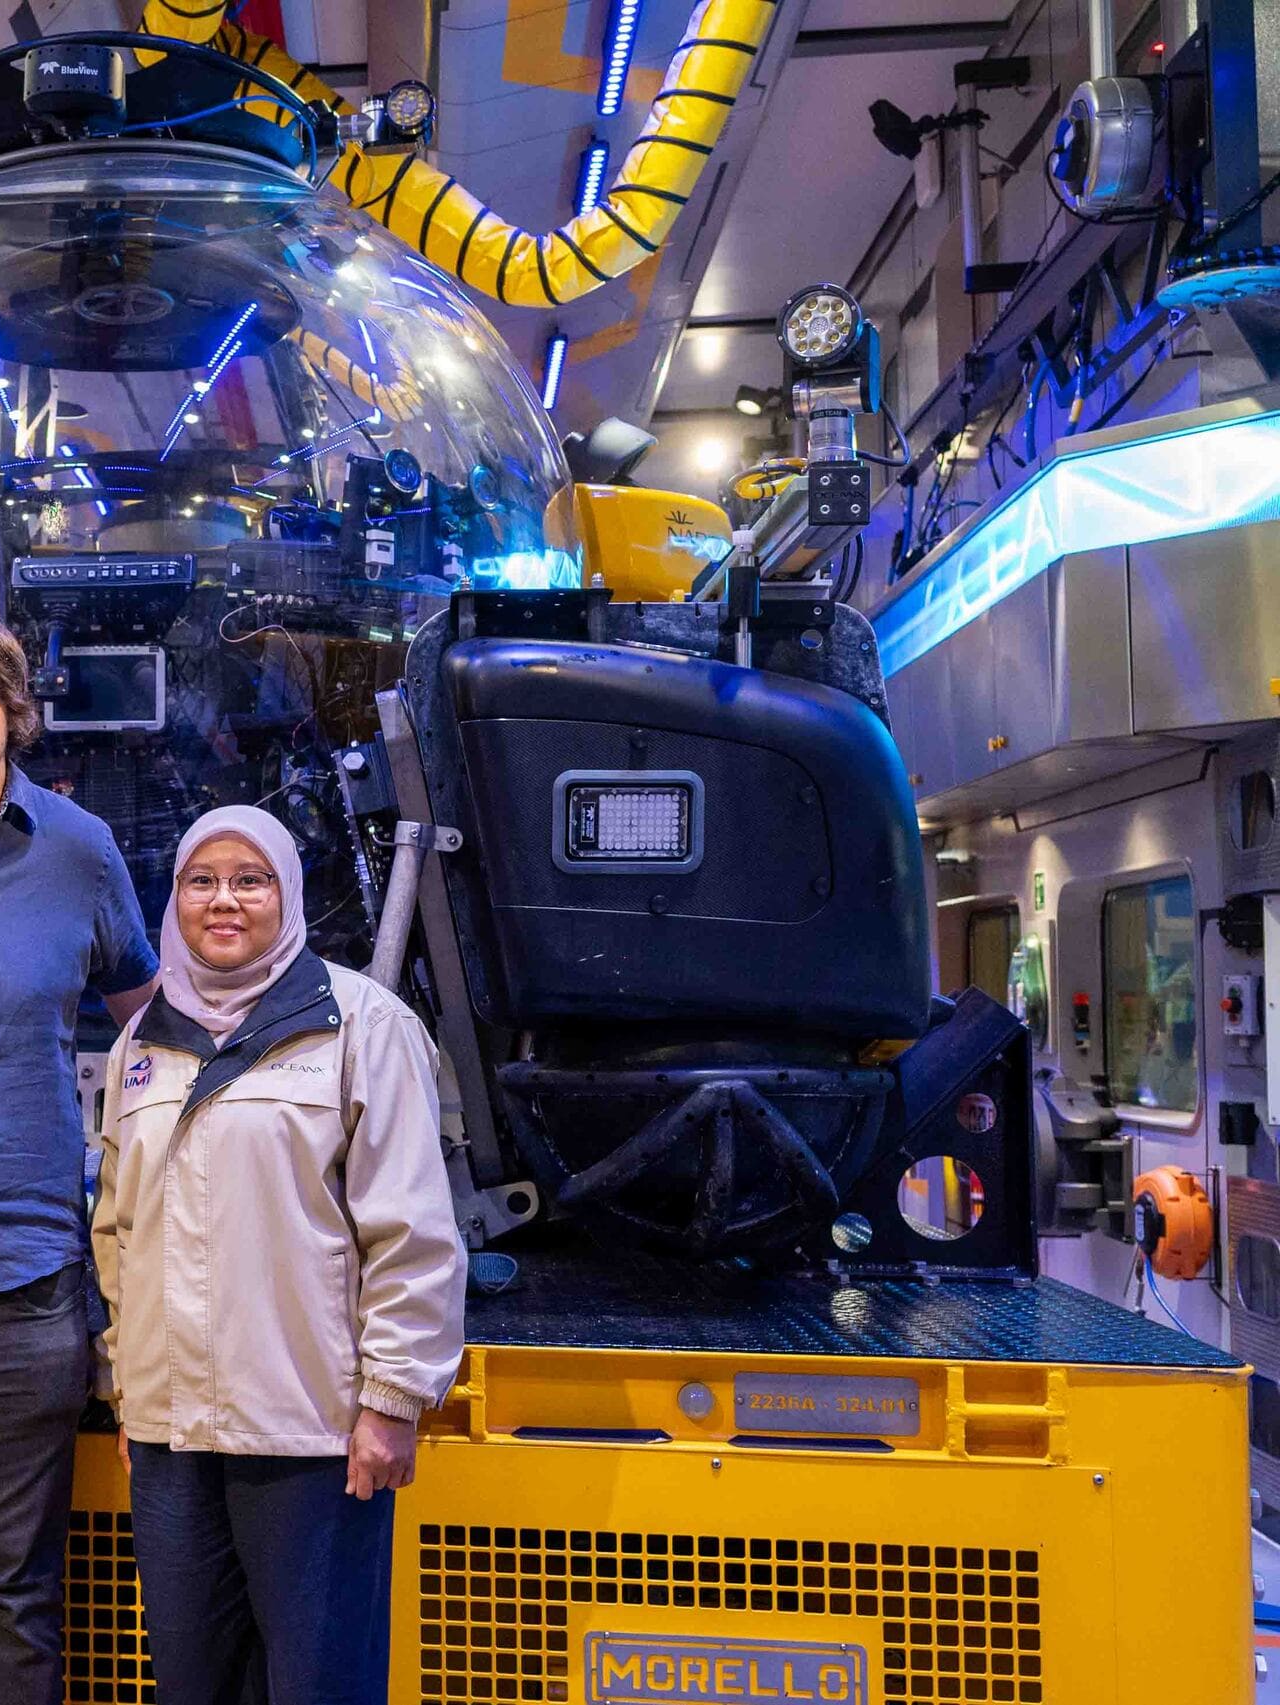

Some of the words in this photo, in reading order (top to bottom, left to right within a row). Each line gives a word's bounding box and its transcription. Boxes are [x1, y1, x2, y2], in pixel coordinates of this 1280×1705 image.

[61, 65, 99, 76] BlueView
[271, 1063, 326, 1078] OCEANX
[601, 1652, 849, 1701] MORELLO
